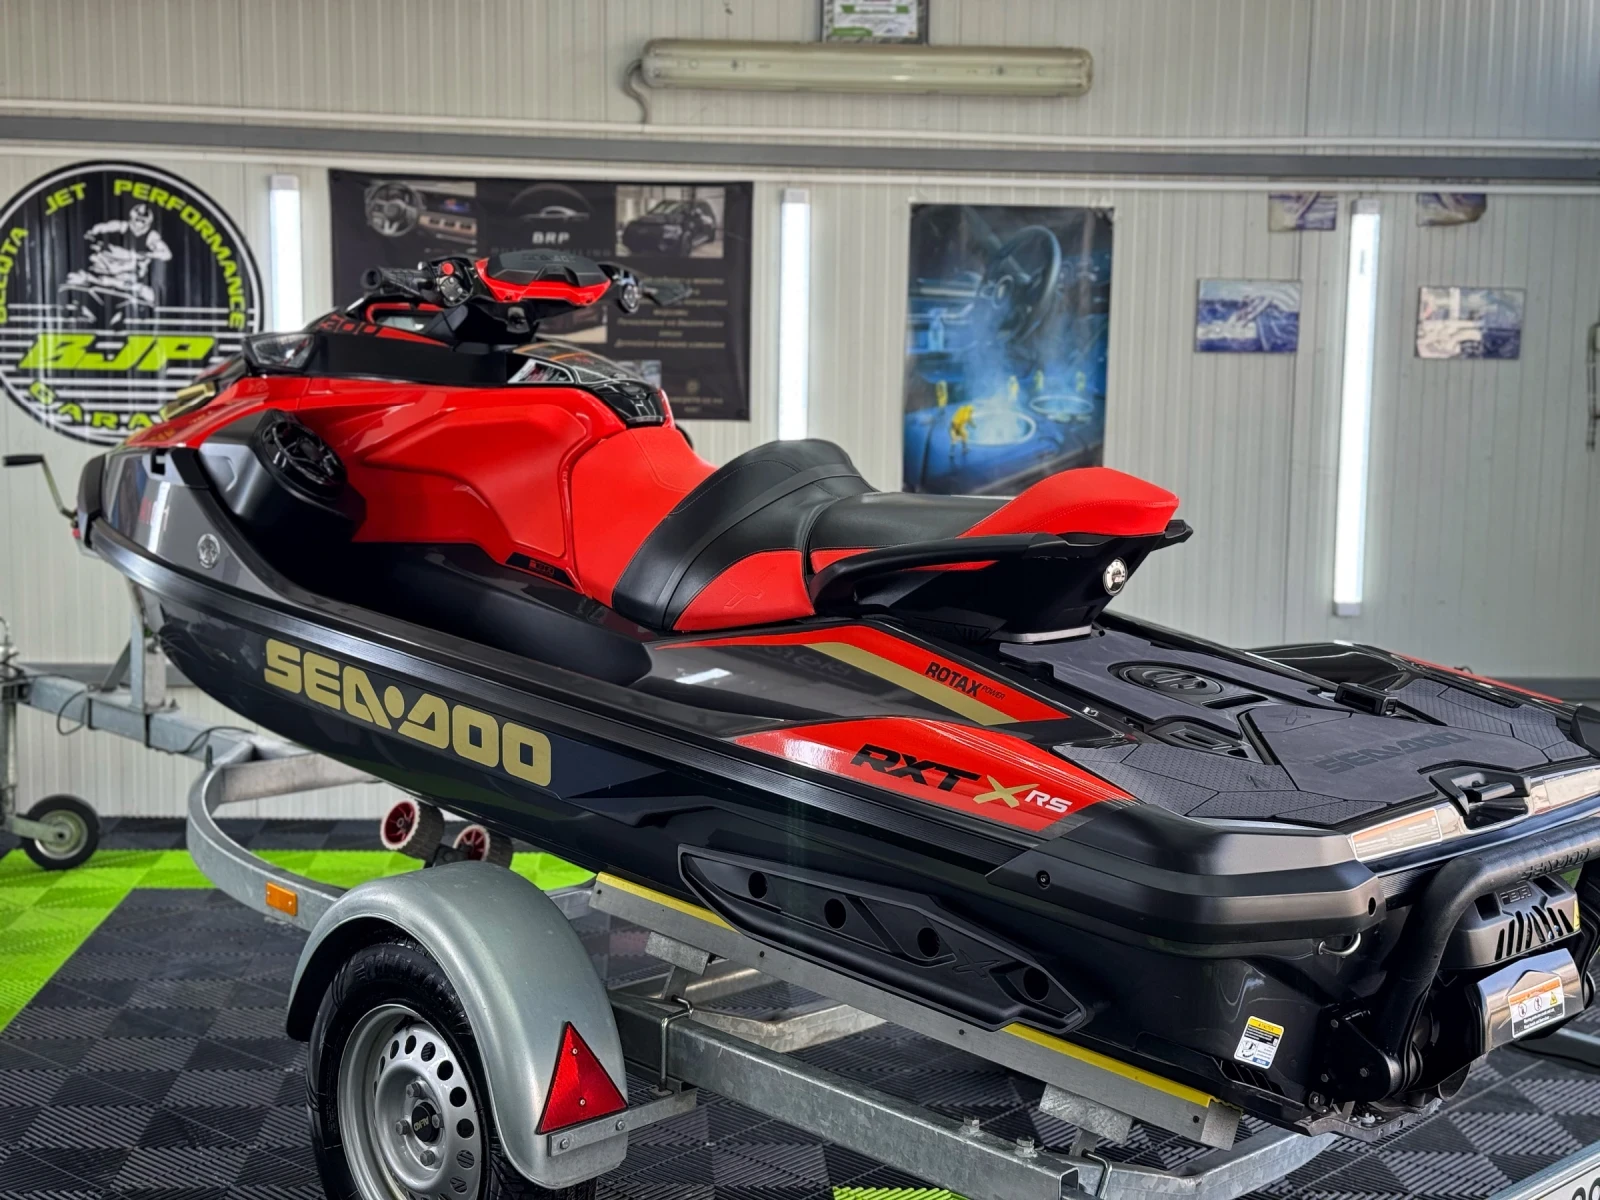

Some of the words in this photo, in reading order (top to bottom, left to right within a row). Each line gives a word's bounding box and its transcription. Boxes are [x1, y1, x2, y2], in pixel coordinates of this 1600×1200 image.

[45, 182, 87, 216] JET
[113, 178, 247, 330] PERFORMANCE
[19, 334, 215, 370] BJP
[924, 661, 983, 697] ROTAX
[981, 684, 1006, 700] POWER
[850, 743, 980, 792] RXT
[1024, 789, 1074, 814] RS
